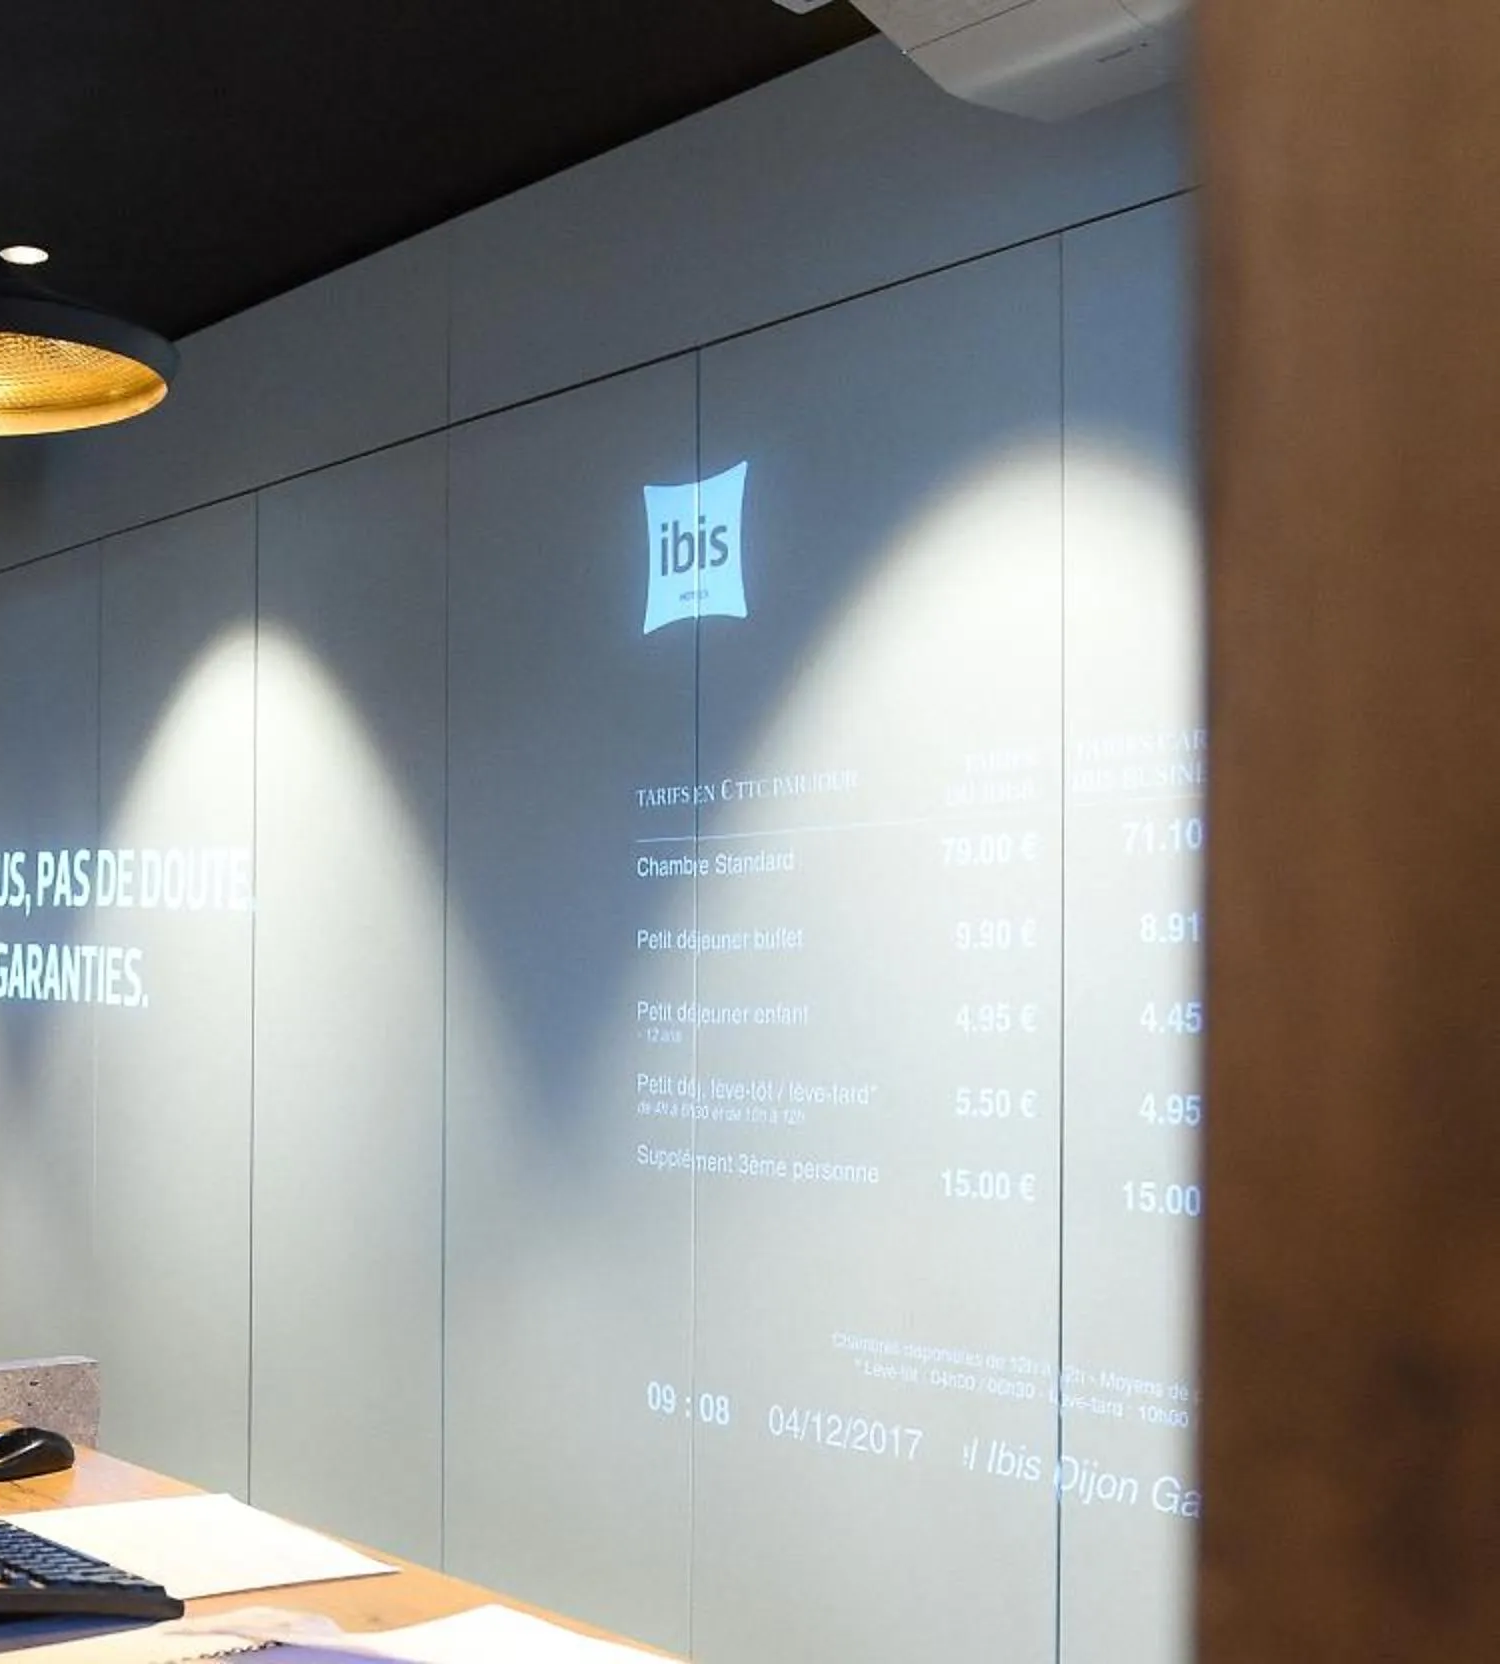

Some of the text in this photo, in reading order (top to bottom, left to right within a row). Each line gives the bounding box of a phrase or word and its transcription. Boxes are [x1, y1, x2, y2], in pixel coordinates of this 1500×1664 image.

[661, 515, 729, 576] ibis
[636, 786, 690, 808] TARIFS
[693, 783, 716, 805] EN
[735, 779, 771, 800] TTC
[941, 830, 1041, 867] 79.00 €
[1121, 817, 1203, 854] 71.10
[36, 848, 92, 908] PAS
[96, 848, 136, 908] DE
[636, 847, 796, 878] Chambre Standard
[637, 928, 673, 950] Petit
[754, 926, 804, 951] buffet
[954, 917, 1038, 950] 9.90 €
[1140, 911, 1201, 943] 8.91
[637, 1000, 673, 1021] Petit
[754, 1002, 809, 1026] enfant
[954, 1002, 1039, 1035] 4.95 €
[1139, 1002, 1202, 1035] 4.45
[637, 1073, 673, 1095] Petit
[954, 1087, 1039, 1118] 5.50 €
[1138, 1092, 1202, 1126] 4.95
[637, 1143, 880, 1184] Supplément 3ème personne
[940, 1167, 1037, 1201] 15.00 €
[1123, 1180, 1202, 1217] 15.00
[647, 1381, 677, 1414] 09
[699, 1393, 731, 1425] 08
[768, 1404, 924, 1460] 04/12/2017
[987, 1440, 1042, 1482] Ibis
[1053, 1454, 1139, 1505] Dijon
